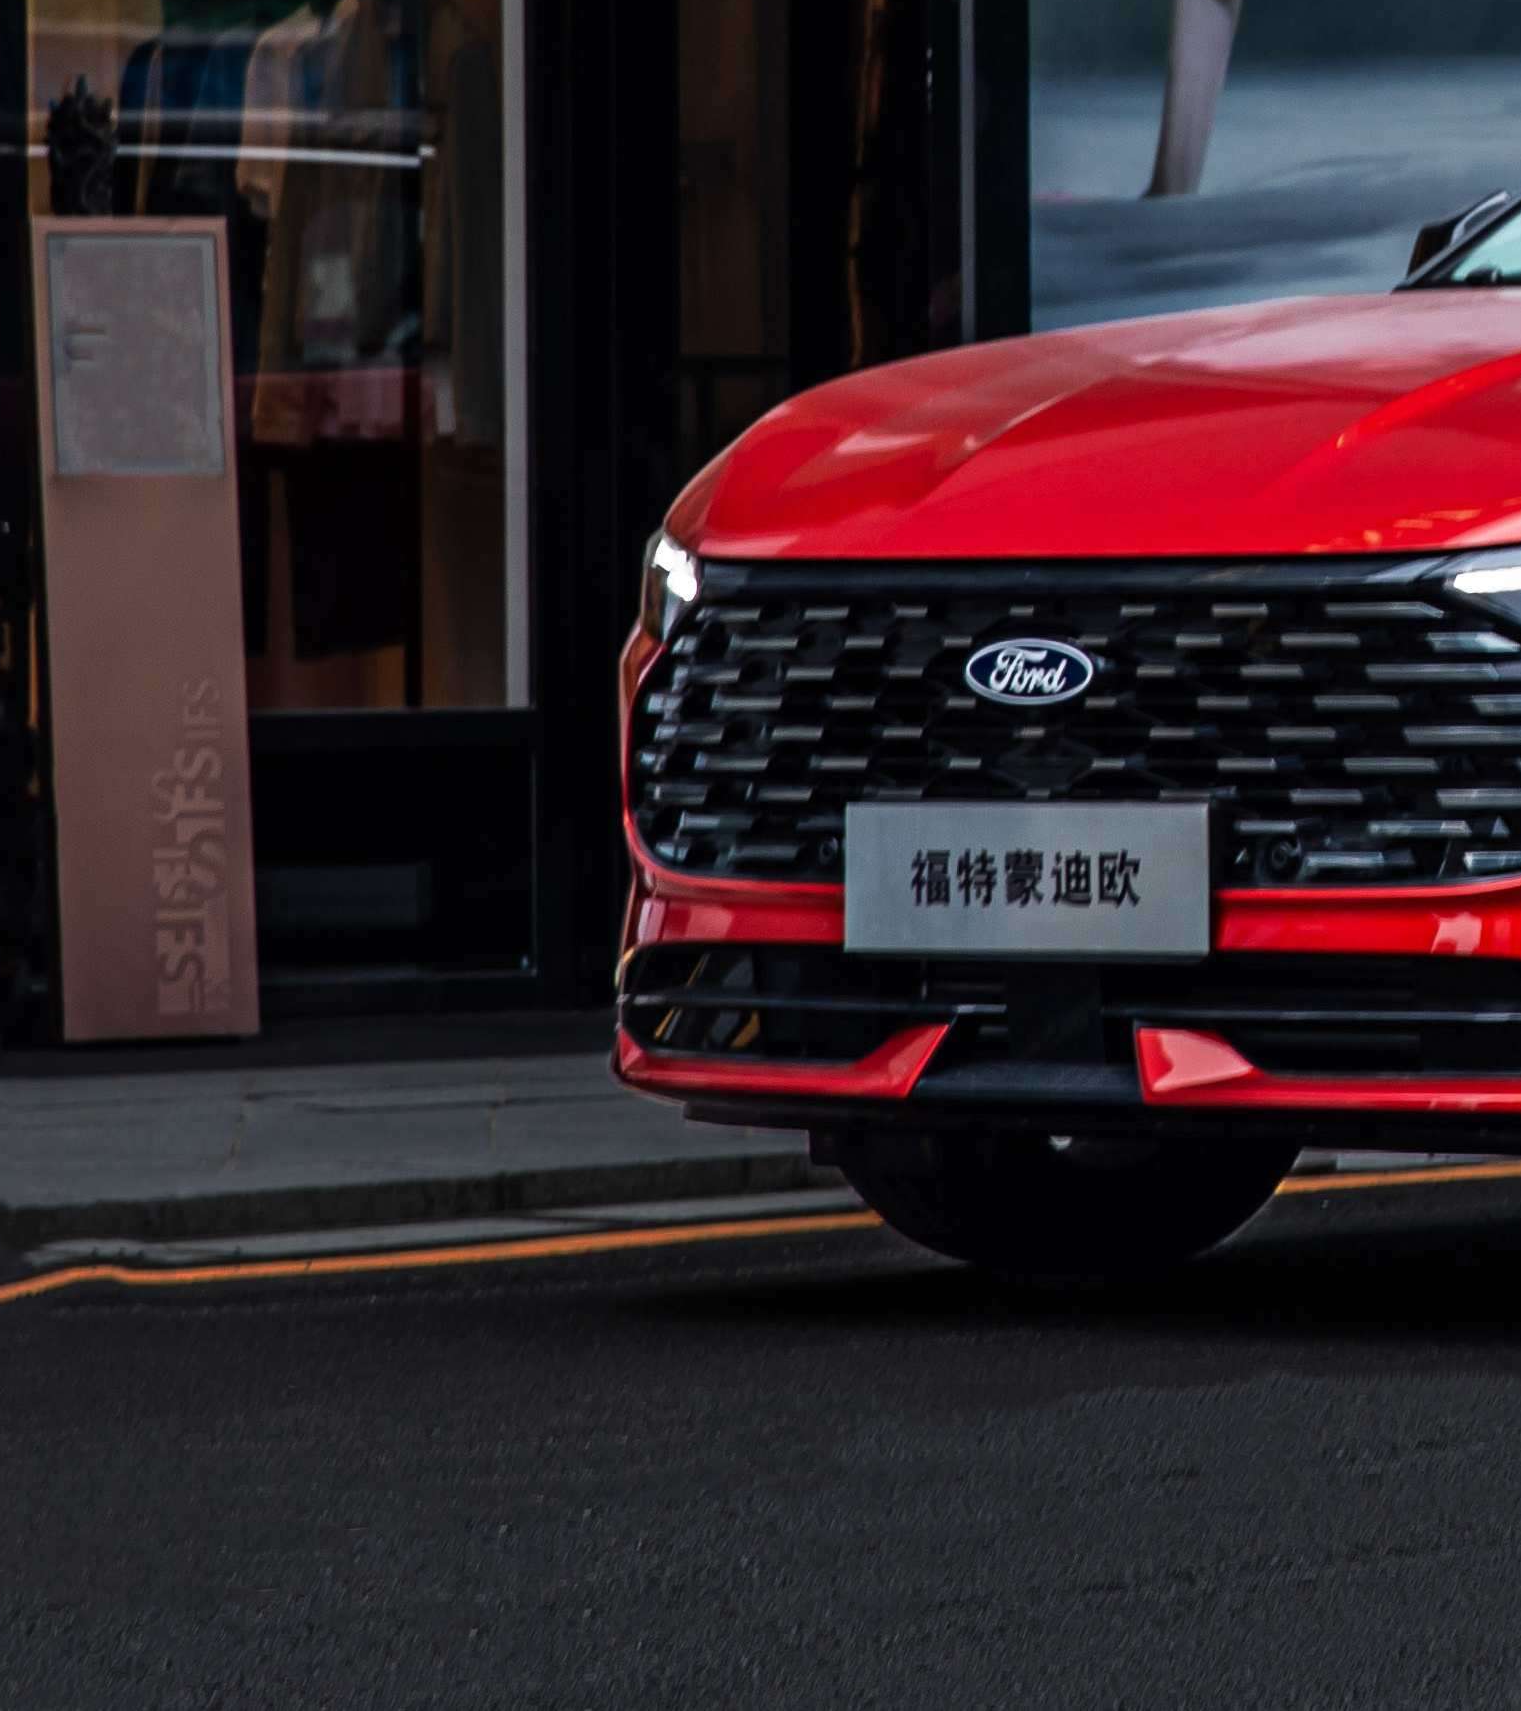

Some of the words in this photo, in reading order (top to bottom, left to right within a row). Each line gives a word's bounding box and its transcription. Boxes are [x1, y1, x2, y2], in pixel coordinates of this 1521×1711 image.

[989, 647, 1068, 693] Ford
[911, 849, 1141, 908] 福特蒙迪欧
